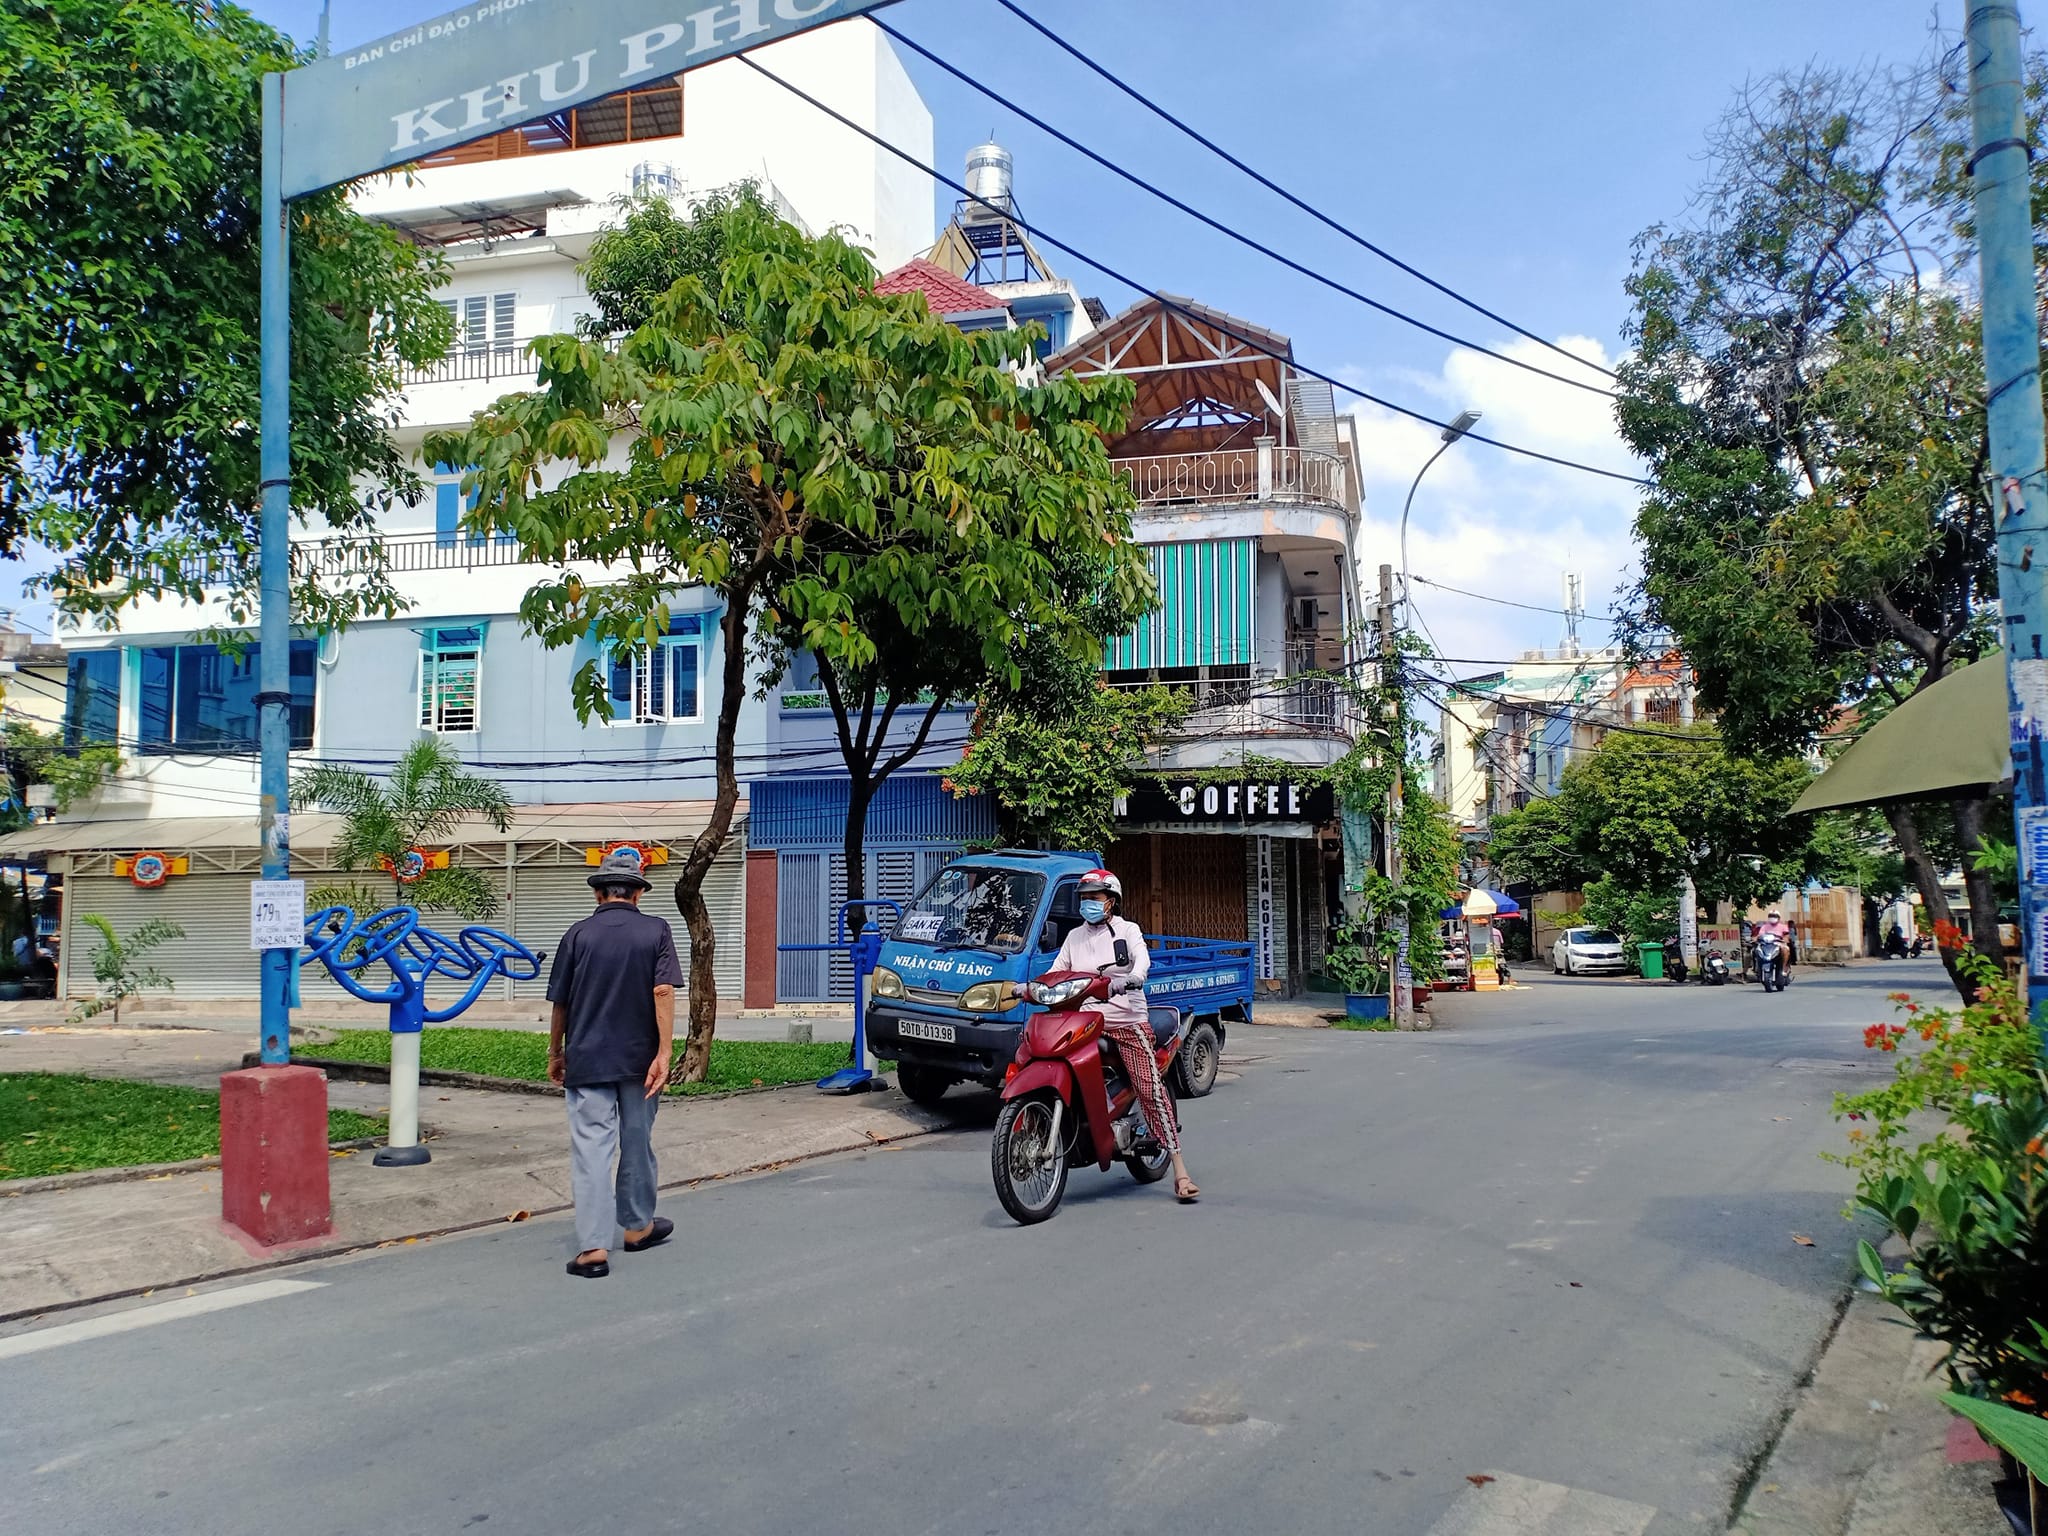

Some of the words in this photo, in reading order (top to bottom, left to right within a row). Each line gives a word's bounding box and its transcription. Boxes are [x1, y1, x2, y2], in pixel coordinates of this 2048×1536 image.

[344, 46, 384, 70] BAN
[428, 15, 471, 37] ĐẠO
[390, 48, 597, 153] KHU
[1179, 785, 1301, 816] COFFEE
[1261, 899, 1271, 978] COFFEE
[900, 1021, 953, 1041] 50TD-013.98
